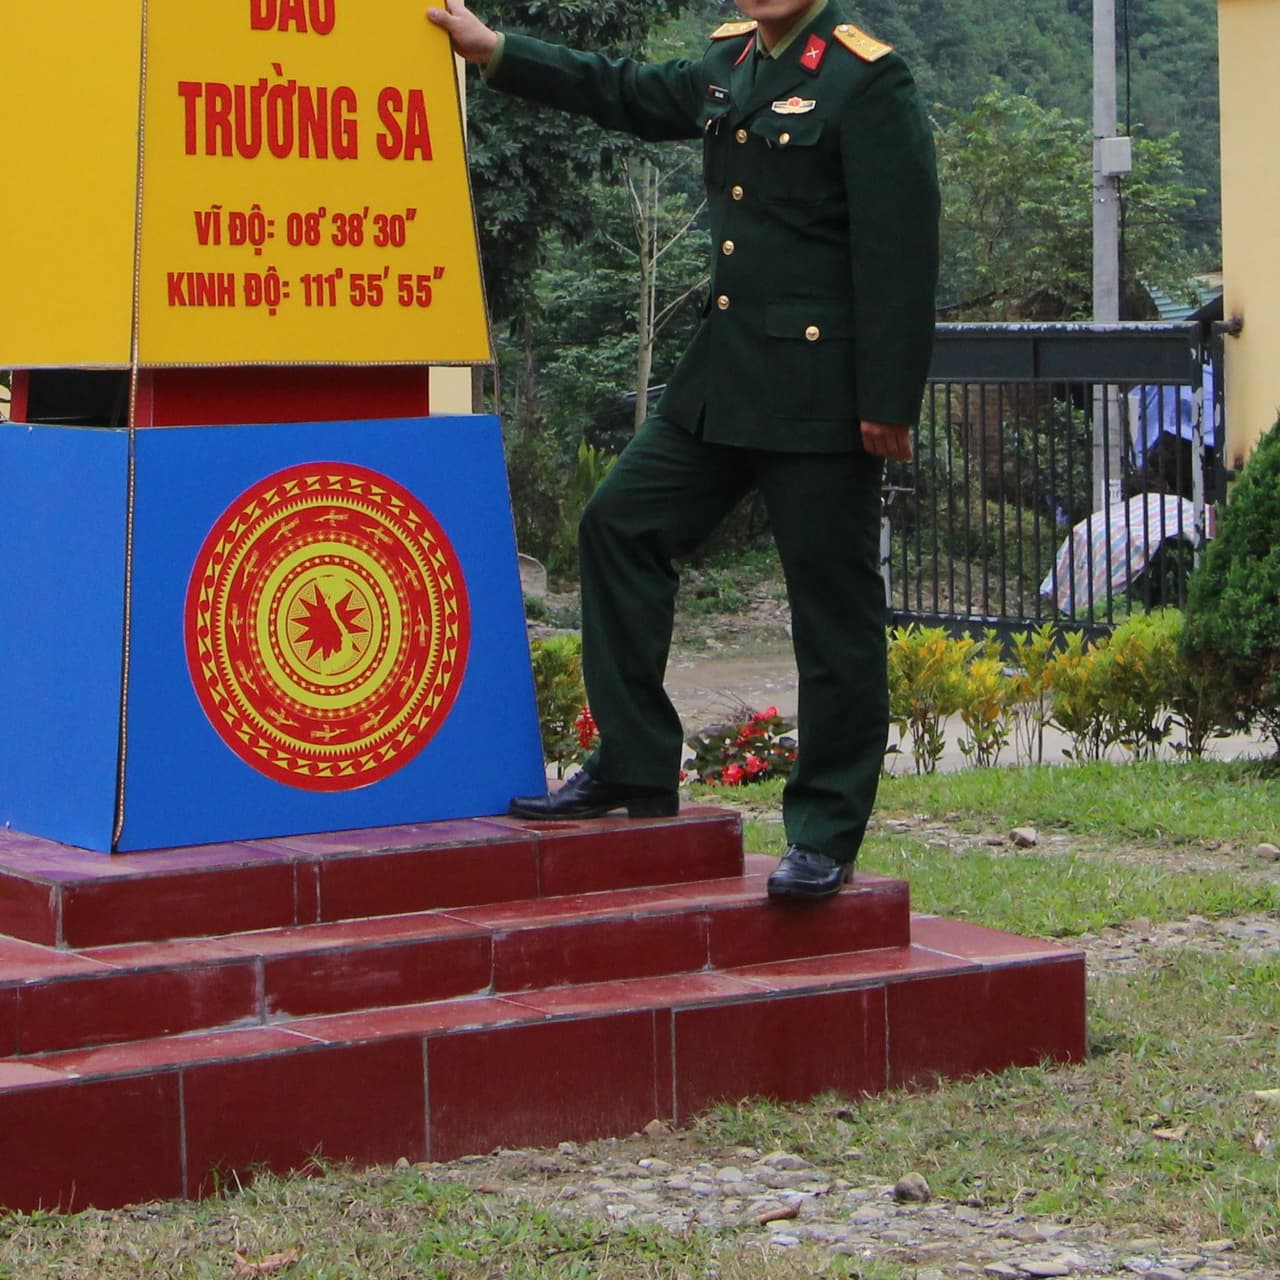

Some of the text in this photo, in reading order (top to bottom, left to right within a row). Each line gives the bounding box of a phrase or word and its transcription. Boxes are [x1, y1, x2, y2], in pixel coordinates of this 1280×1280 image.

[178, 63, 433, 161] TRƯỜNG SA
[194, 204, 223, 246] VĨ
[227, 204, 275, 256] ĐỘ:
[167, 272, 235, 307] KINH
[243, 266, 290, 316] ĐỘ:
